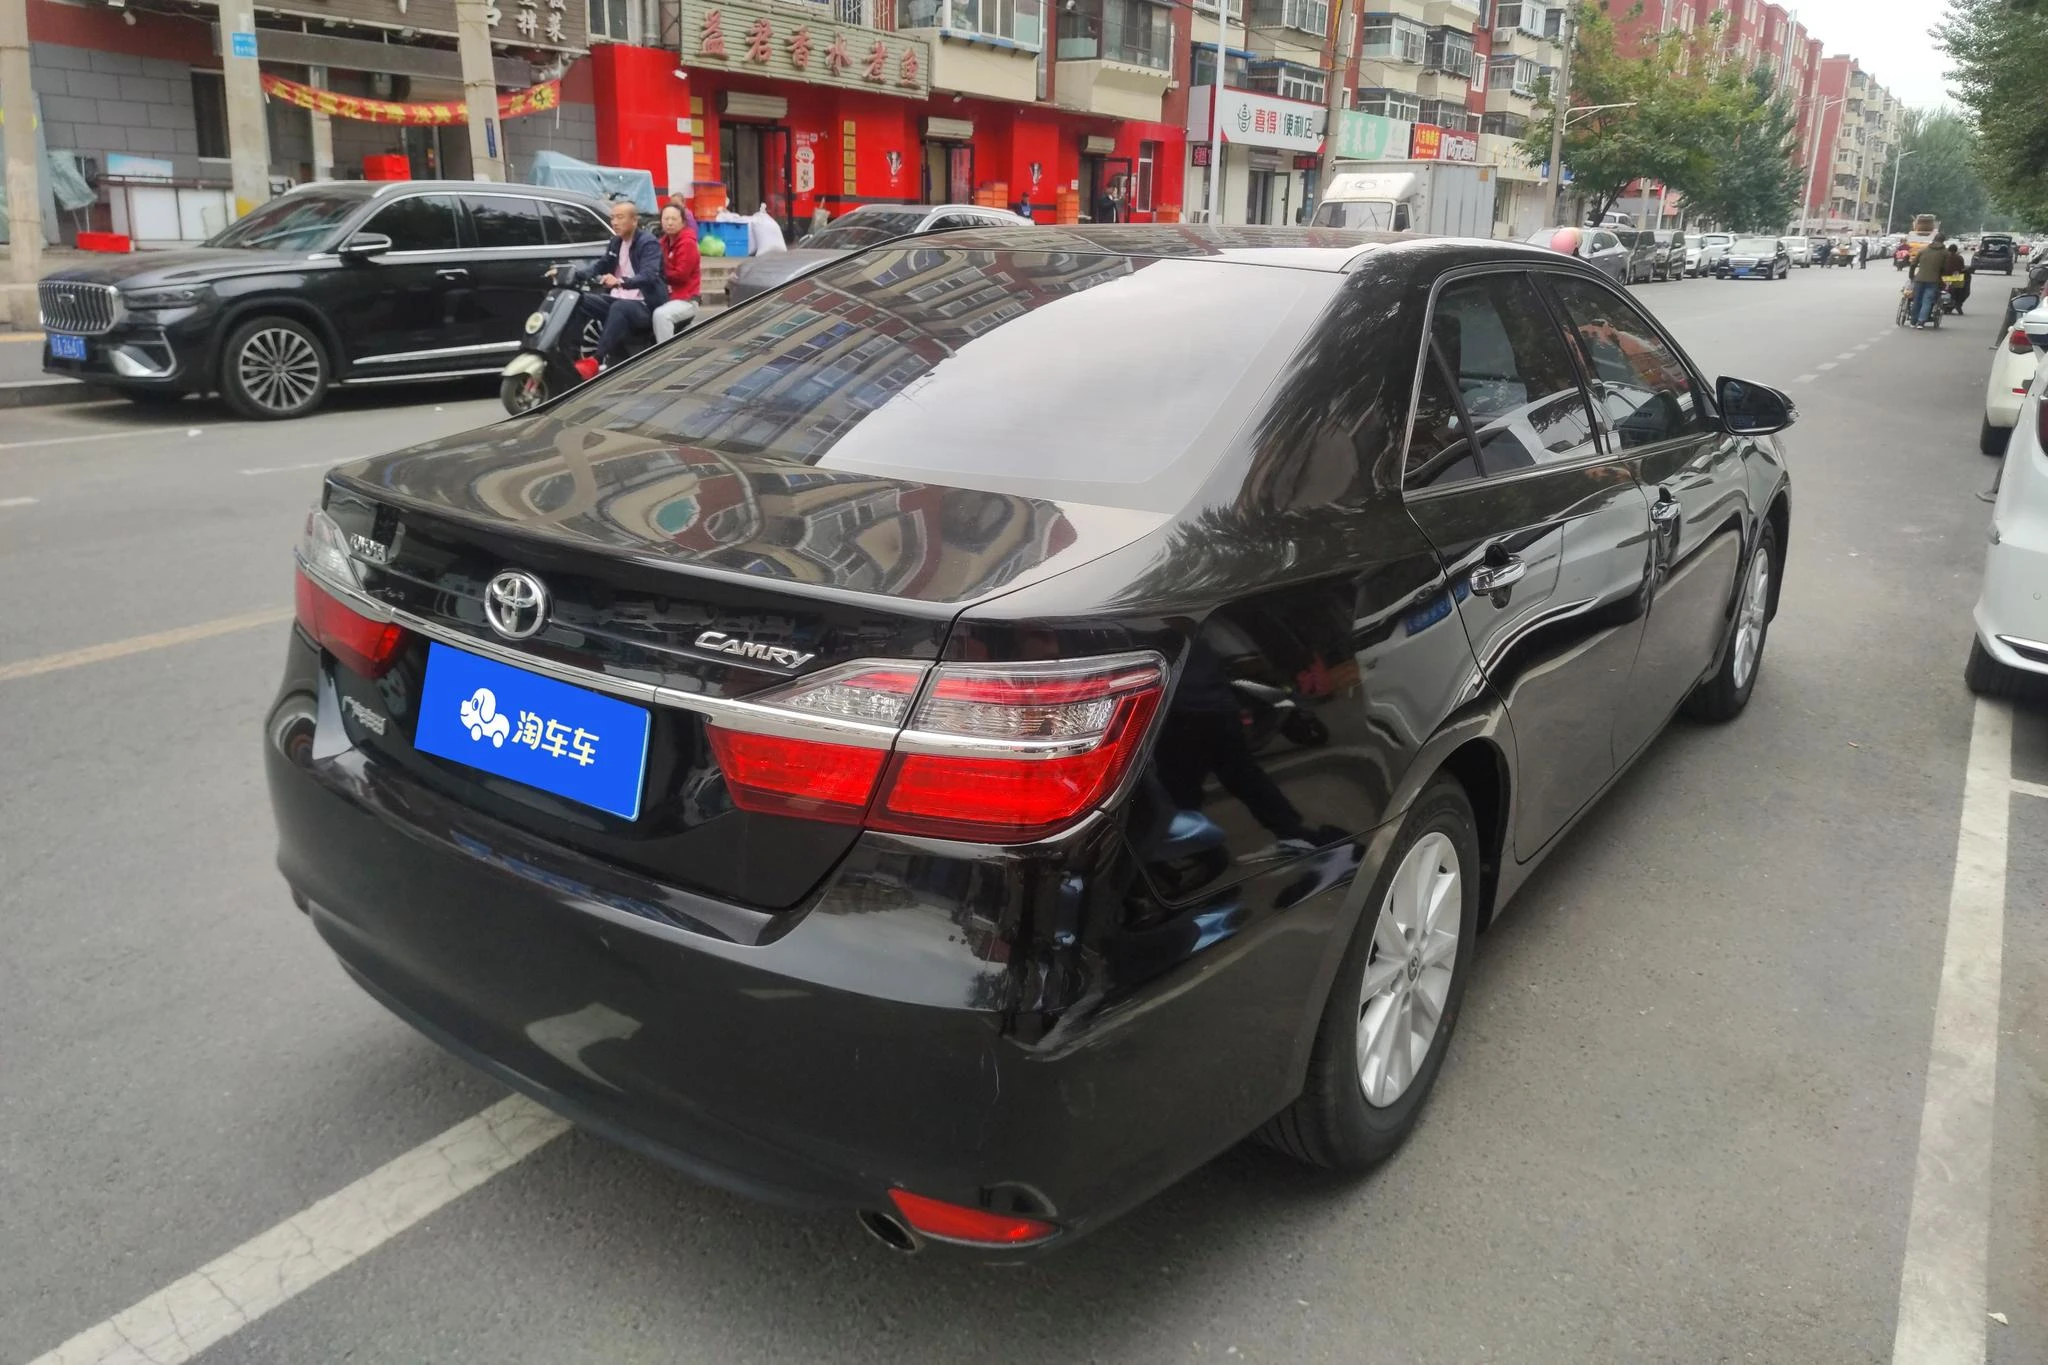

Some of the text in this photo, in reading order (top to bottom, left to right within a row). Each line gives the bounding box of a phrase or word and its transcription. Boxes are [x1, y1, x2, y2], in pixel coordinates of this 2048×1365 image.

[695, 8, 922, 90] 益君香水煮鱼
[1255, 109, 1313, 140] 喜得 便利店
[695, 631, 815, 669] CAMRY
